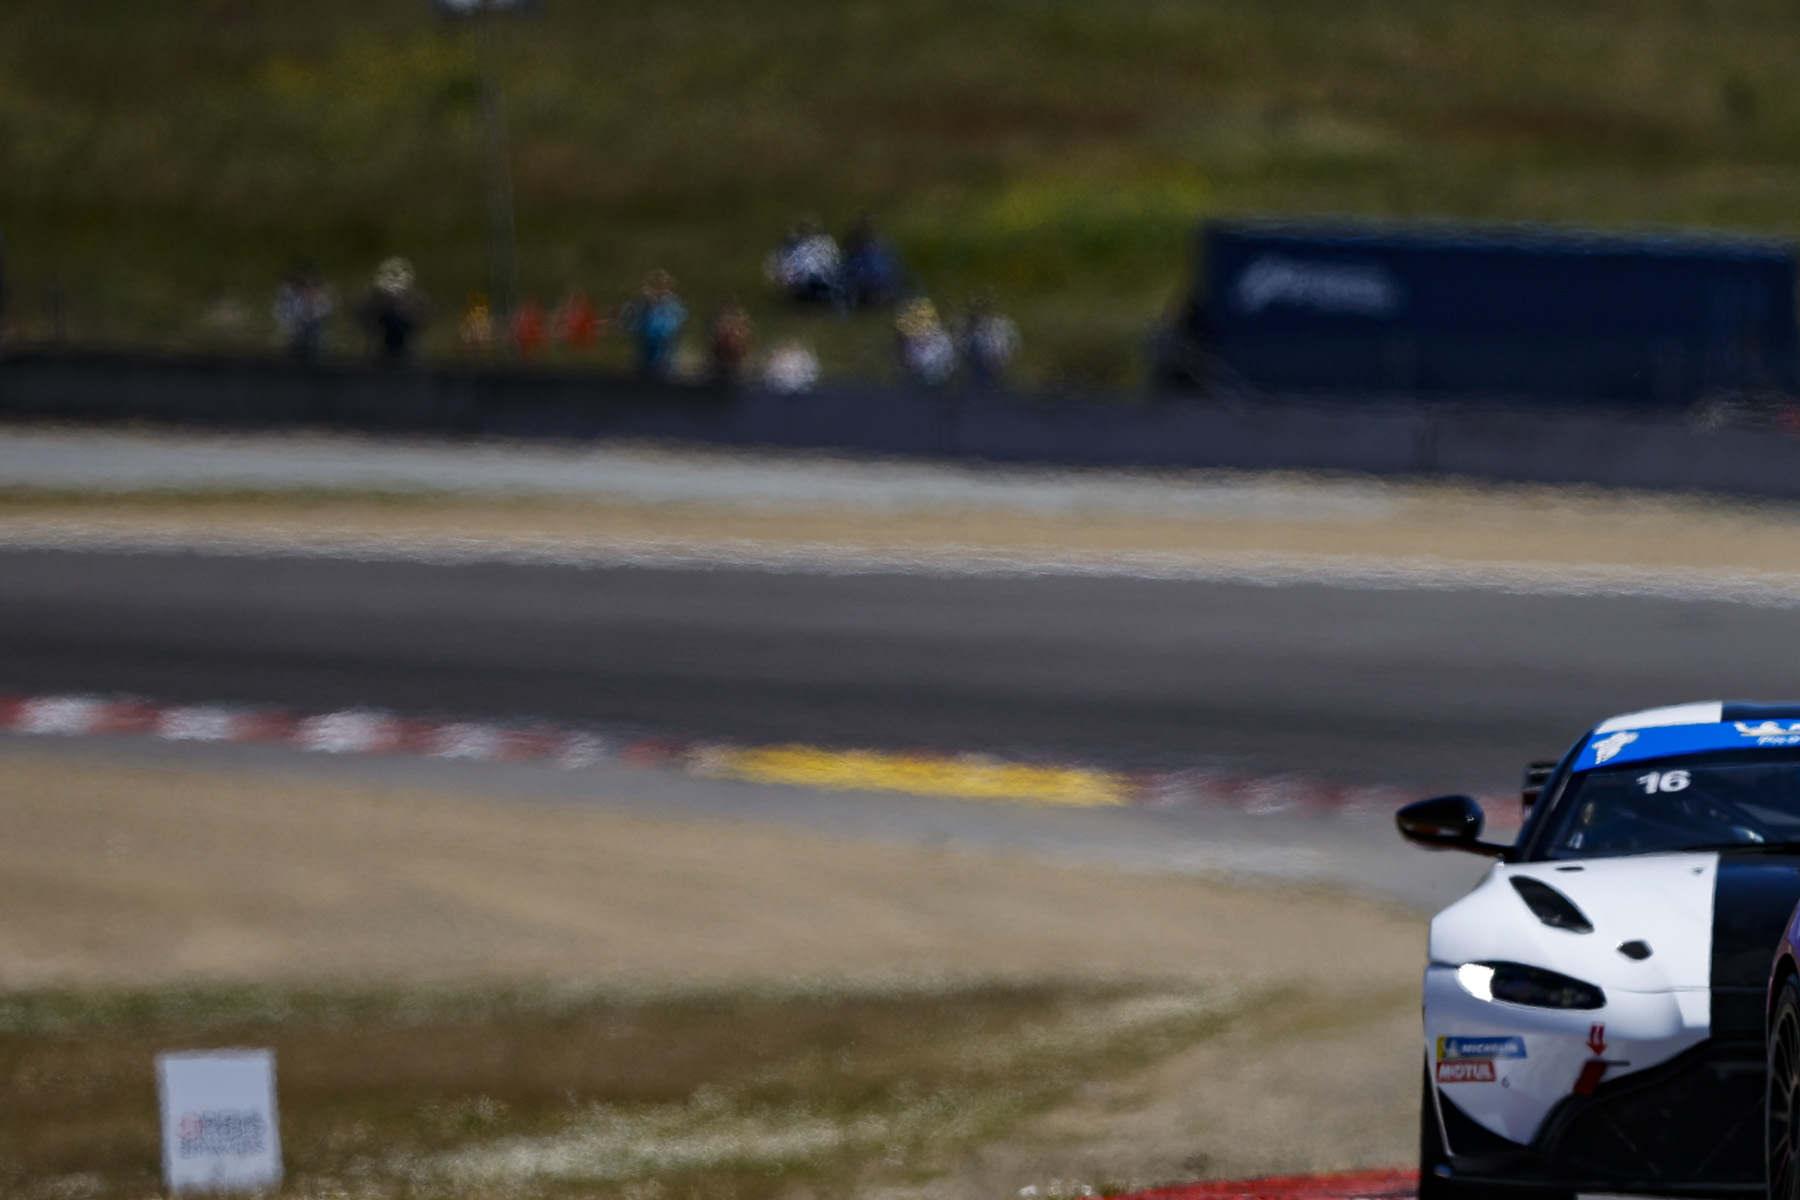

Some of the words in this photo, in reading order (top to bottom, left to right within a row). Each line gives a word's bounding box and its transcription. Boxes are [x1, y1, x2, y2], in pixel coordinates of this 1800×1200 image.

[1636, 770, 1692, 794] 16
[1462, 1043, 1518, 1053] MICHELIN
[1440, 1064, 1492, 1079] MOTUL
